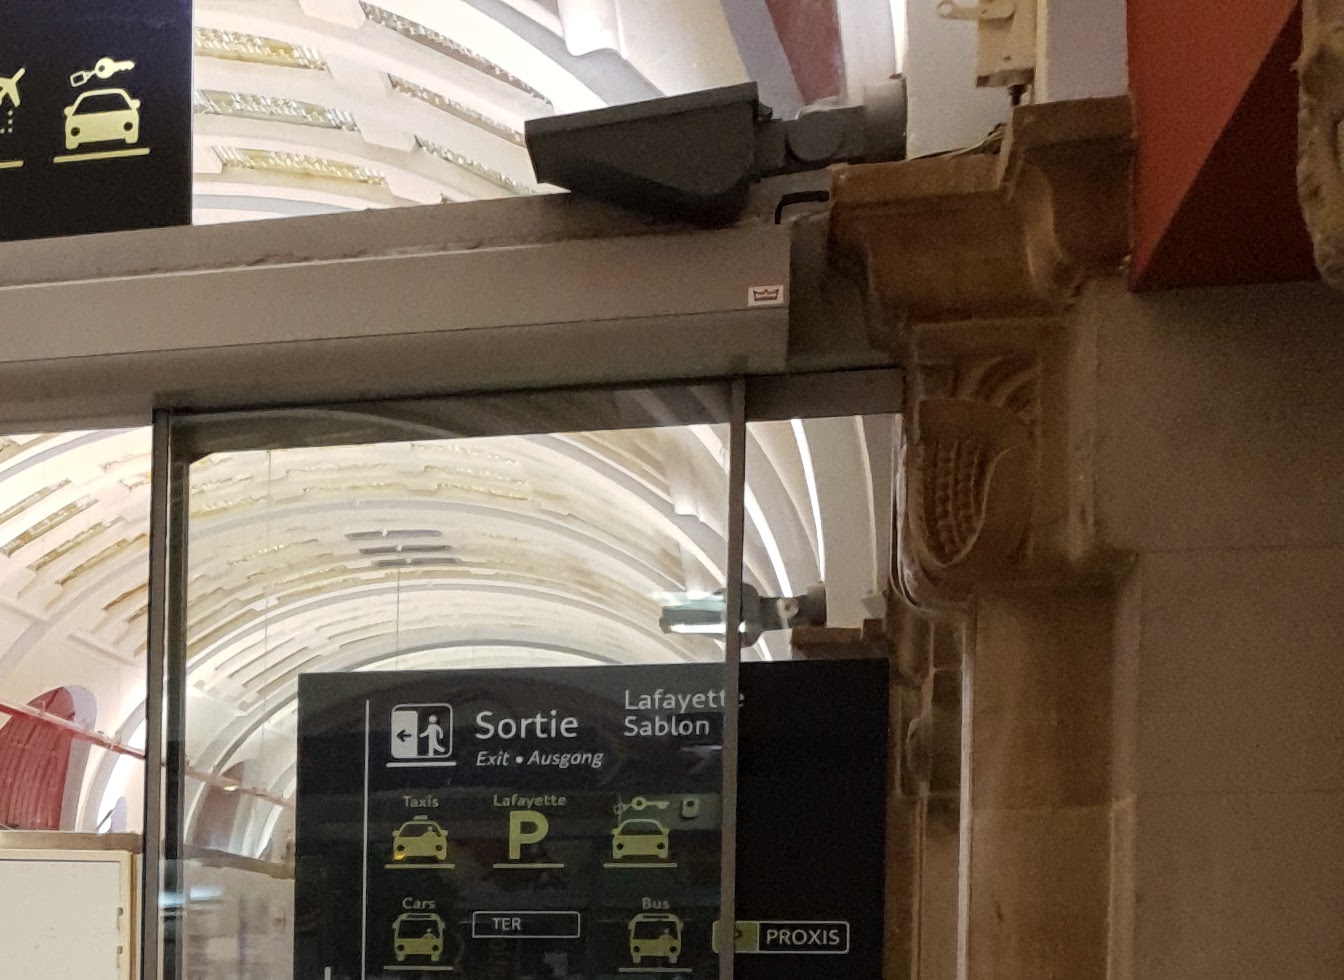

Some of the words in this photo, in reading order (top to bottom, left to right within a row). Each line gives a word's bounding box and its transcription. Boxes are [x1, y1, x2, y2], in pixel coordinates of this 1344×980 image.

[474, 711, 579, 741] Sortie
[623, 715, 710, 736] Sablon
[476, 750, 509, 767] Exit
[527, 750, 604, 769] Ausgang
[403, 795, 439, 808] Taxis
[493, 794, 567, 809] Lafayette
[508, 810, 549, 860] P
[402, 897, 436, 910] Cars
[642, 897, 670, 909] Bus
[492, 918, 522, 931] TER
[765, 929, 840, 945] PROXIS
